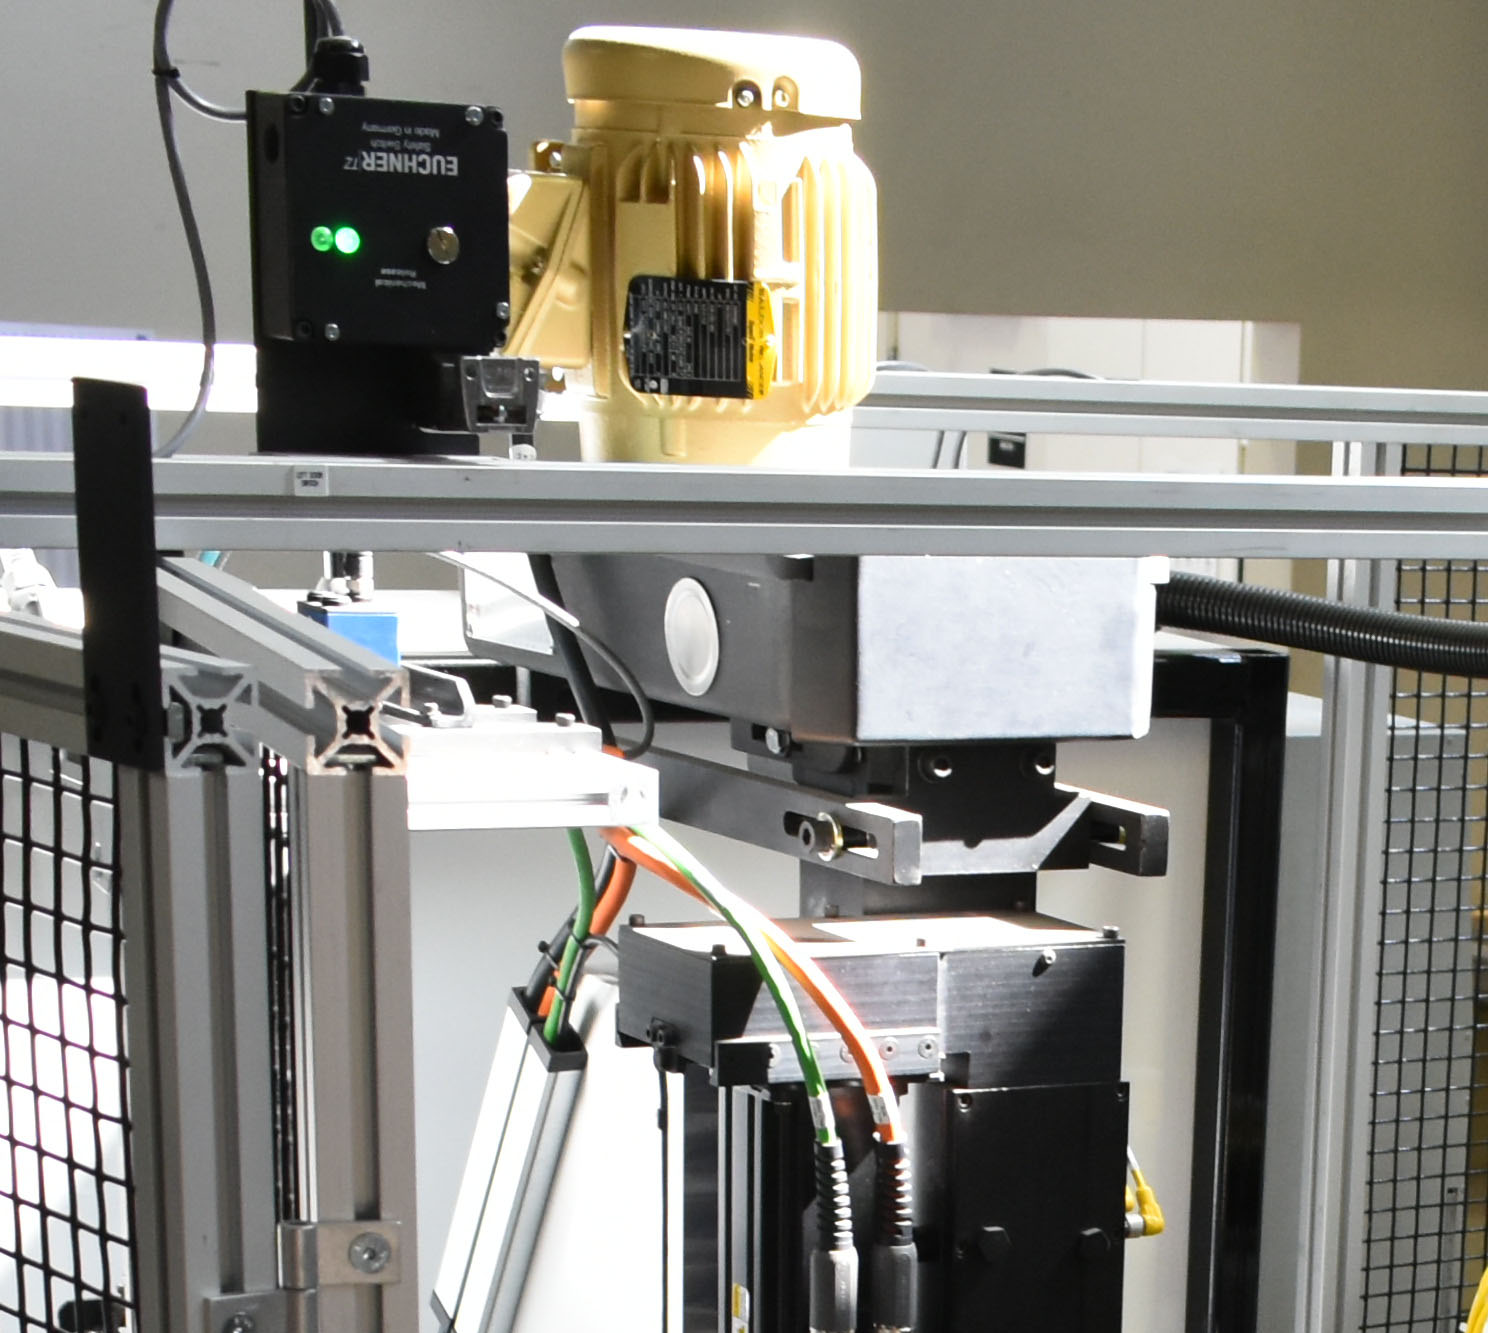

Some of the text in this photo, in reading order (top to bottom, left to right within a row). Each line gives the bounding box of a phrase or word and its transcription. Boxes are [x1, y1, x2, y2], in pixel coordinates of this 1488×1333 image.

[361, 121, 403, 136] Germany
[419, 127, 440, 139] Made
[370, 138, 431, 153] Safety Switch
[361, 151, 459, 177] EUCHNER
[380, 267, 417, 278] Release
[375, 278, 427, 290] Mechanical
